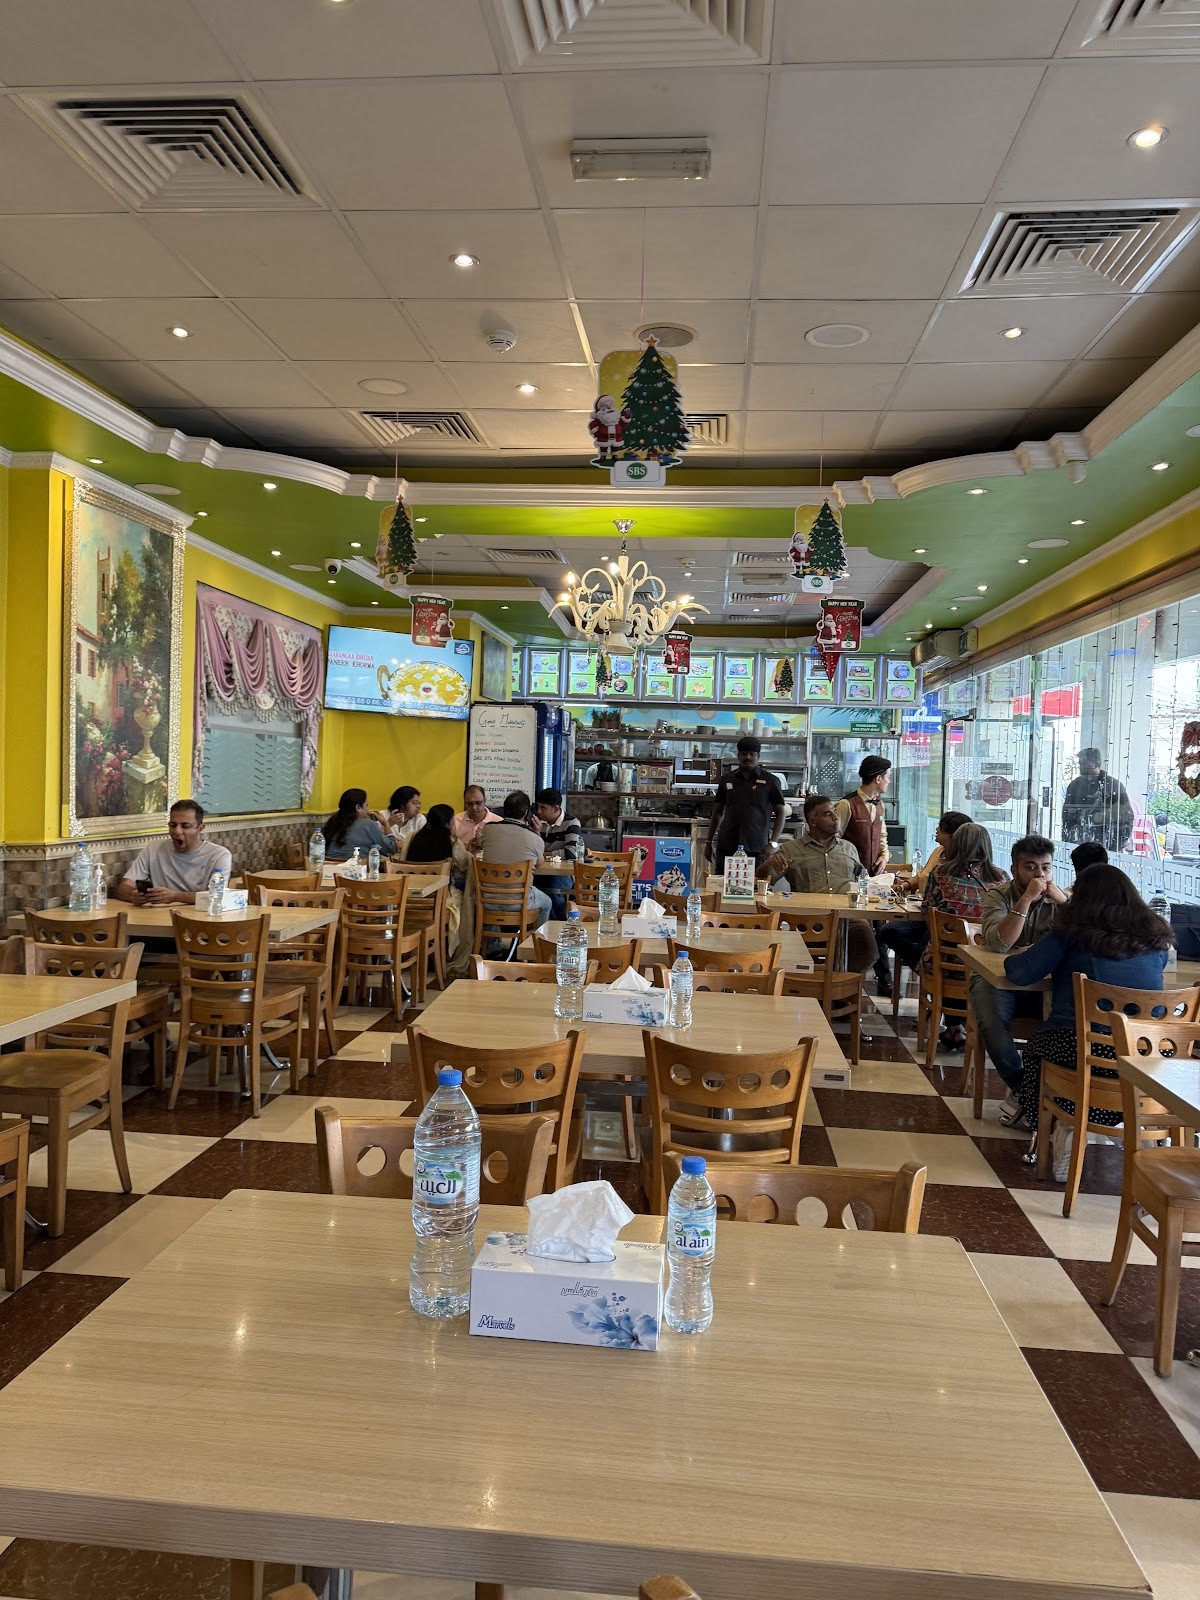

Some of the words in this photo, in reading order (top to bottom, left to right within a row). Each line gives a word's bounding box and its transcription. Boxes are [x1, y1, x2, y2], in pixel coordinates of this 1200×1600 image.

[628, 466, 646, 476] SBS
[632, 883, 652, 891] ET'S
[632, 891, 649, 900] HILL
[420, 1179, 457, 1196] العين
[675, 1235, 687, 1248] al
[688, 1236, 709, 1249] ain
[478, 1314, 516, 1331] Marvels
